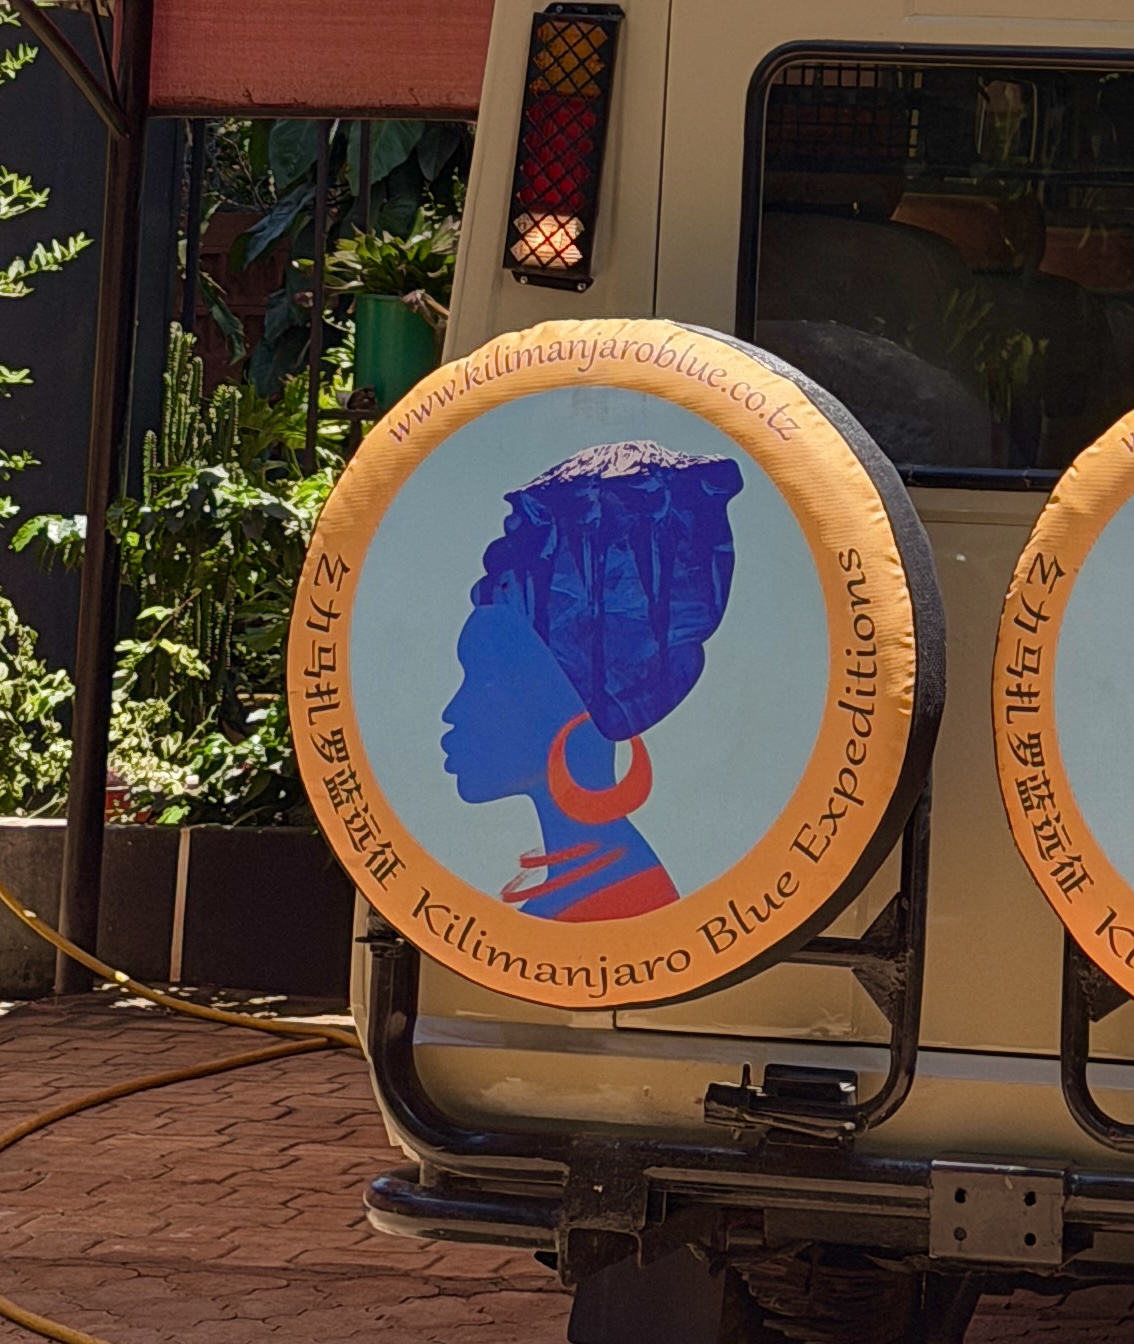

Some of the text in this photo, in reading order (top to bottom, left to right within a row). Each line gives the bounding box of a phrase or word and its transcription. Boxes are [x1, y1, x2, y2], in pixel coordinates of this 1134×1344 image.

[389, 334, 801, 443] www.kilimanjaroblue.co.tz
[304, 552, 407, 892] 乞力马扎罗蓝远征
[411, 547, 877, 999] Kilimanjaro Blue Expeditions
[1005, 552, 1094, 904] 乞力马扎罗蓝远征
